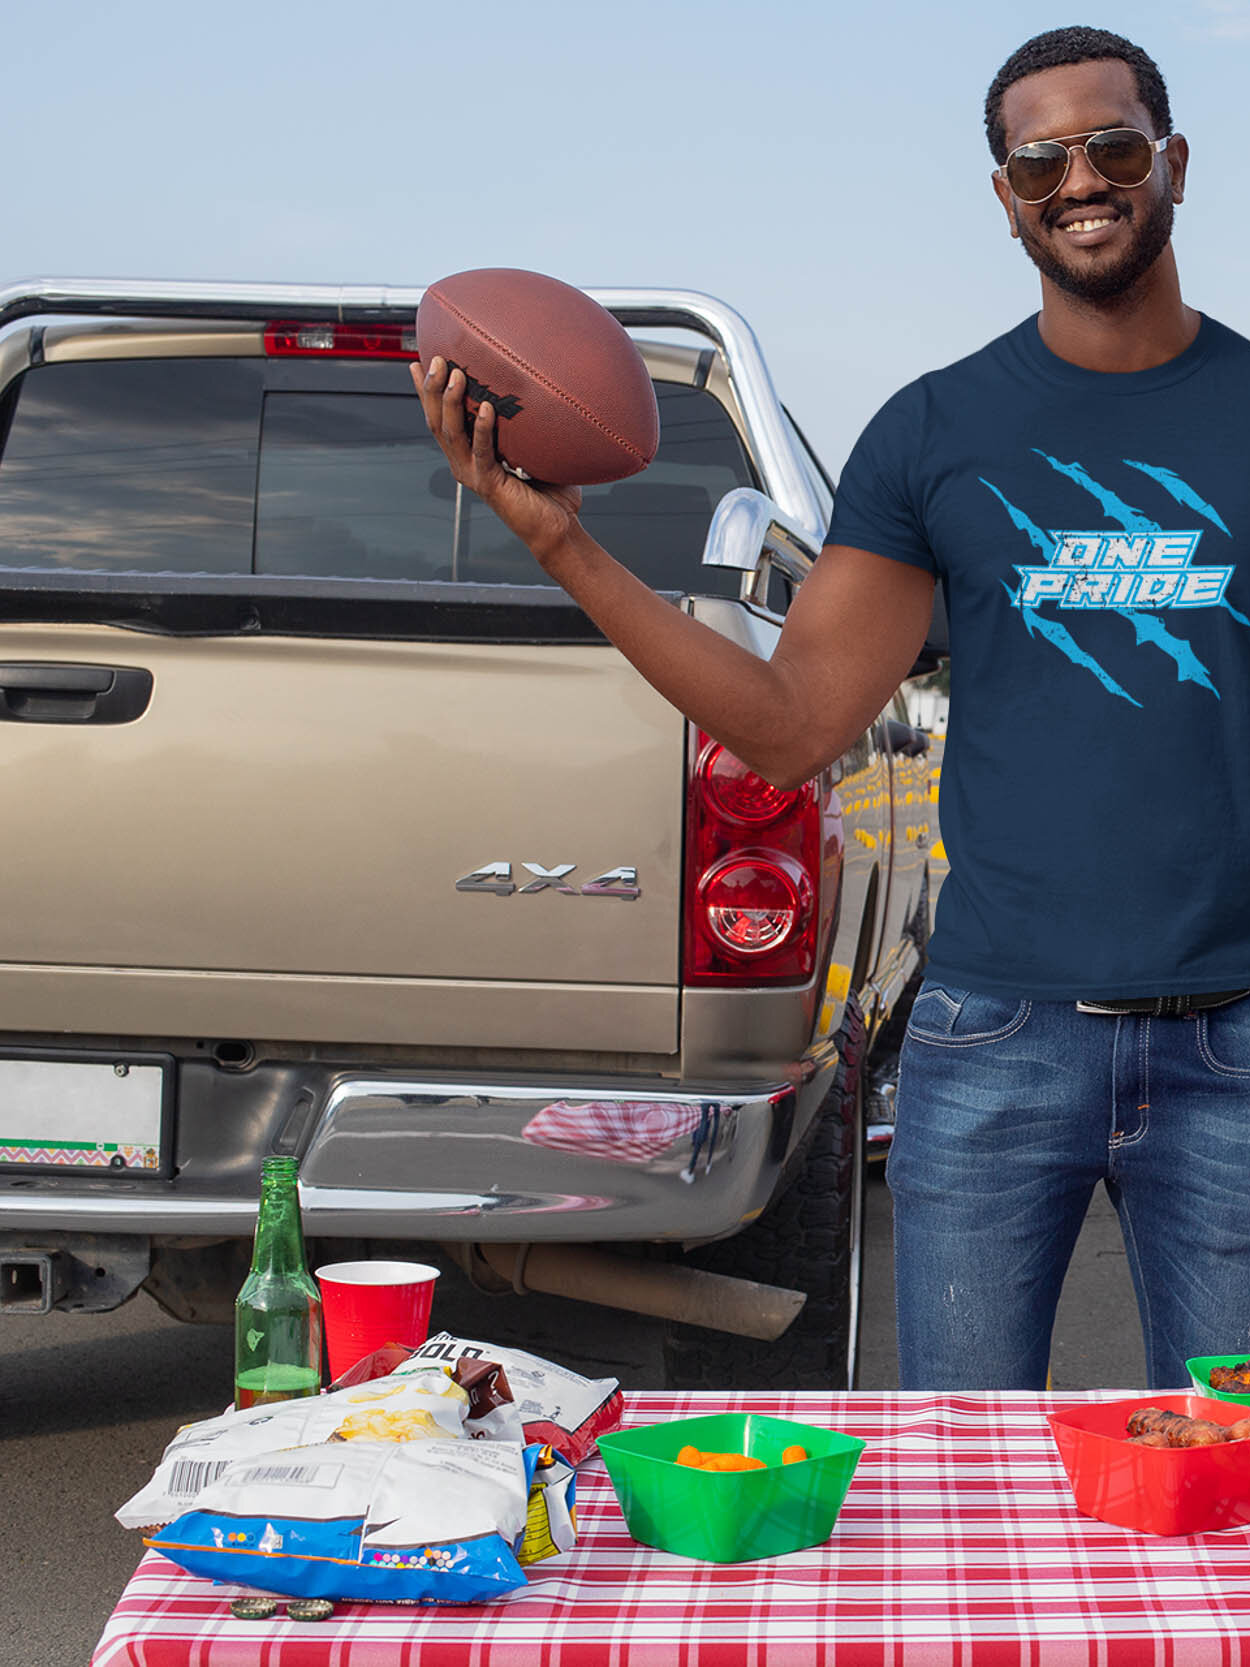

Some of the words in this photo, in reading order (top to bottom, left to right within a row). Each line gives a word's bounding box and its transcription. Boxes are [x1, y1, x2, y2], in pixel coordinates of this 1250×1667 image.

[1052, 533, 1200, 568] ONE
[1016, 568, 1232, 608] PRIDE
[456, 861, 641, 900] 4X4
